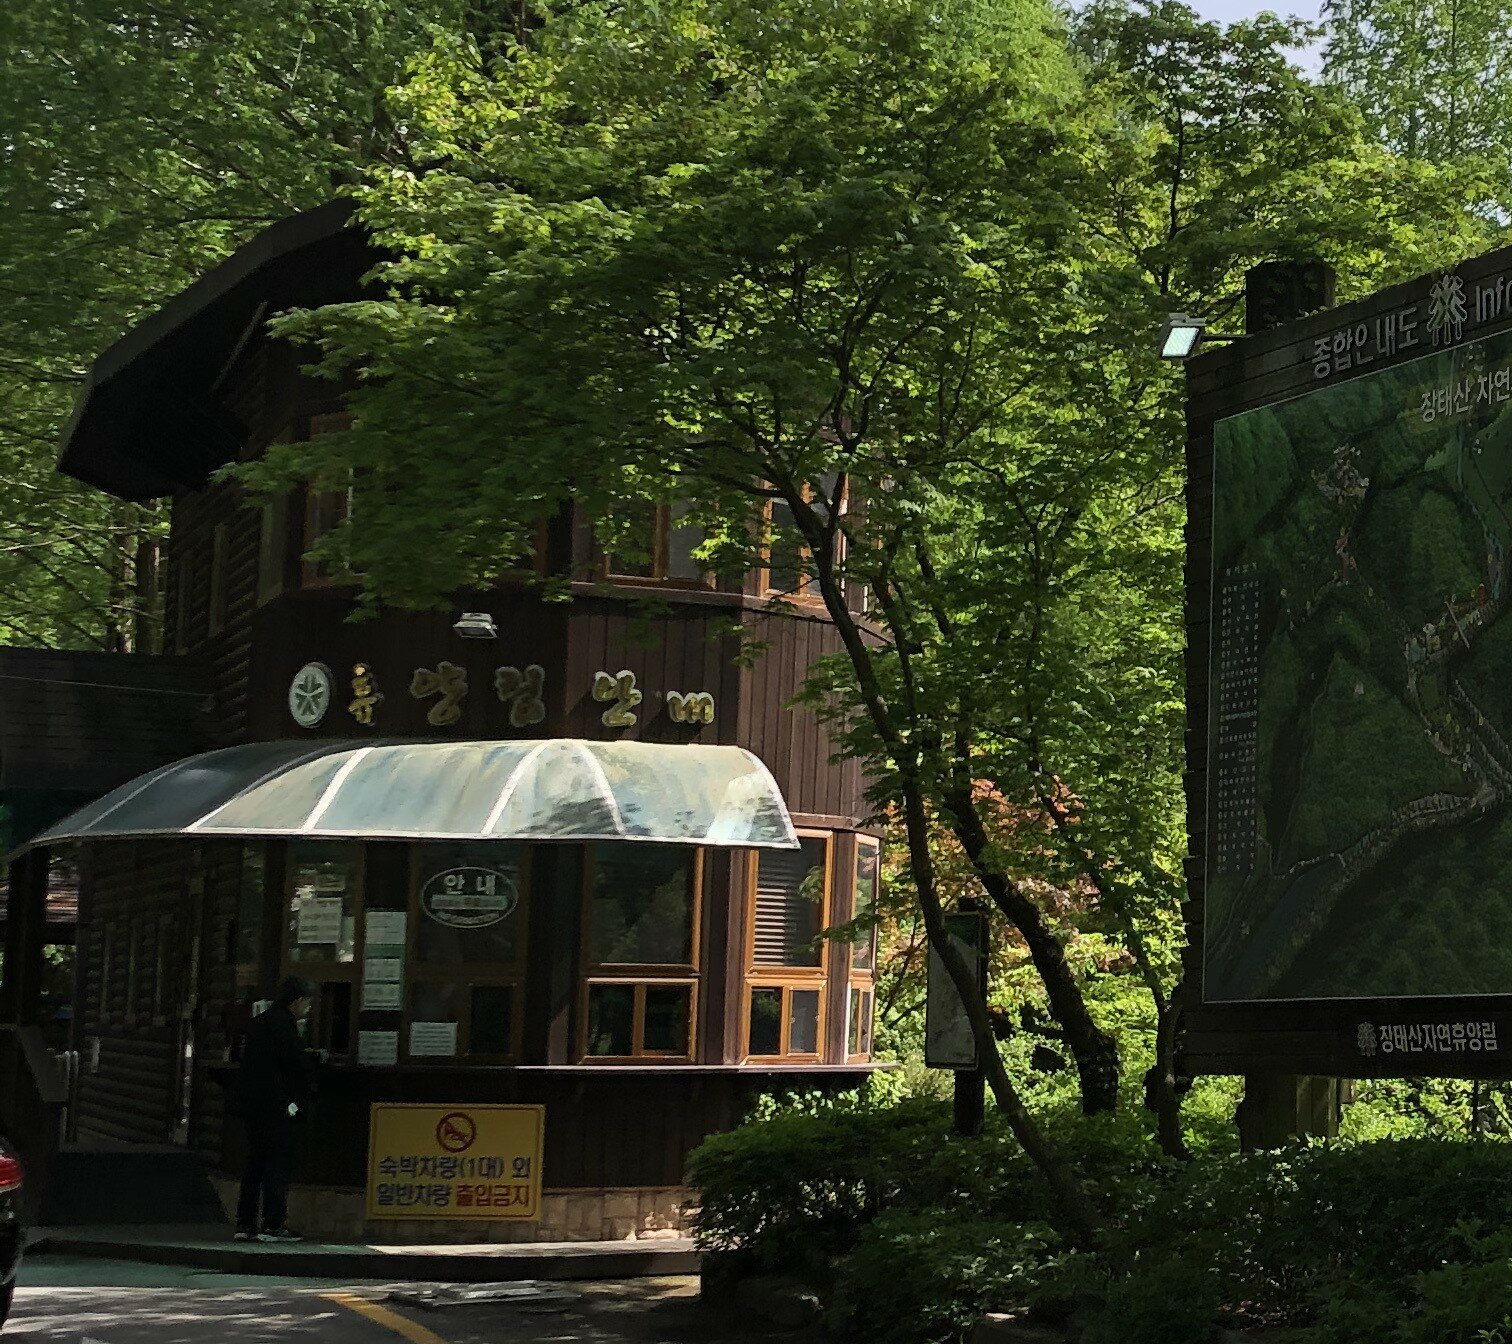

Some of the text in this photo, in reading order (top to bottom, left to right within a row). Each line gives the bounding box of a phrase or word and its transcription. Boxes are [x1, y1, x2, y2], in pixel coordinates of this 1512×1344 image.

[1419, 380, 1472, 423] 장태산
[1379, 1021, 1498, 1054] 장태산자연휴양림
[379, 1155, 532, 1180] 숙박차량(1대) 외
[376, 1183, 531, 1208] 일반차량 출입금지
